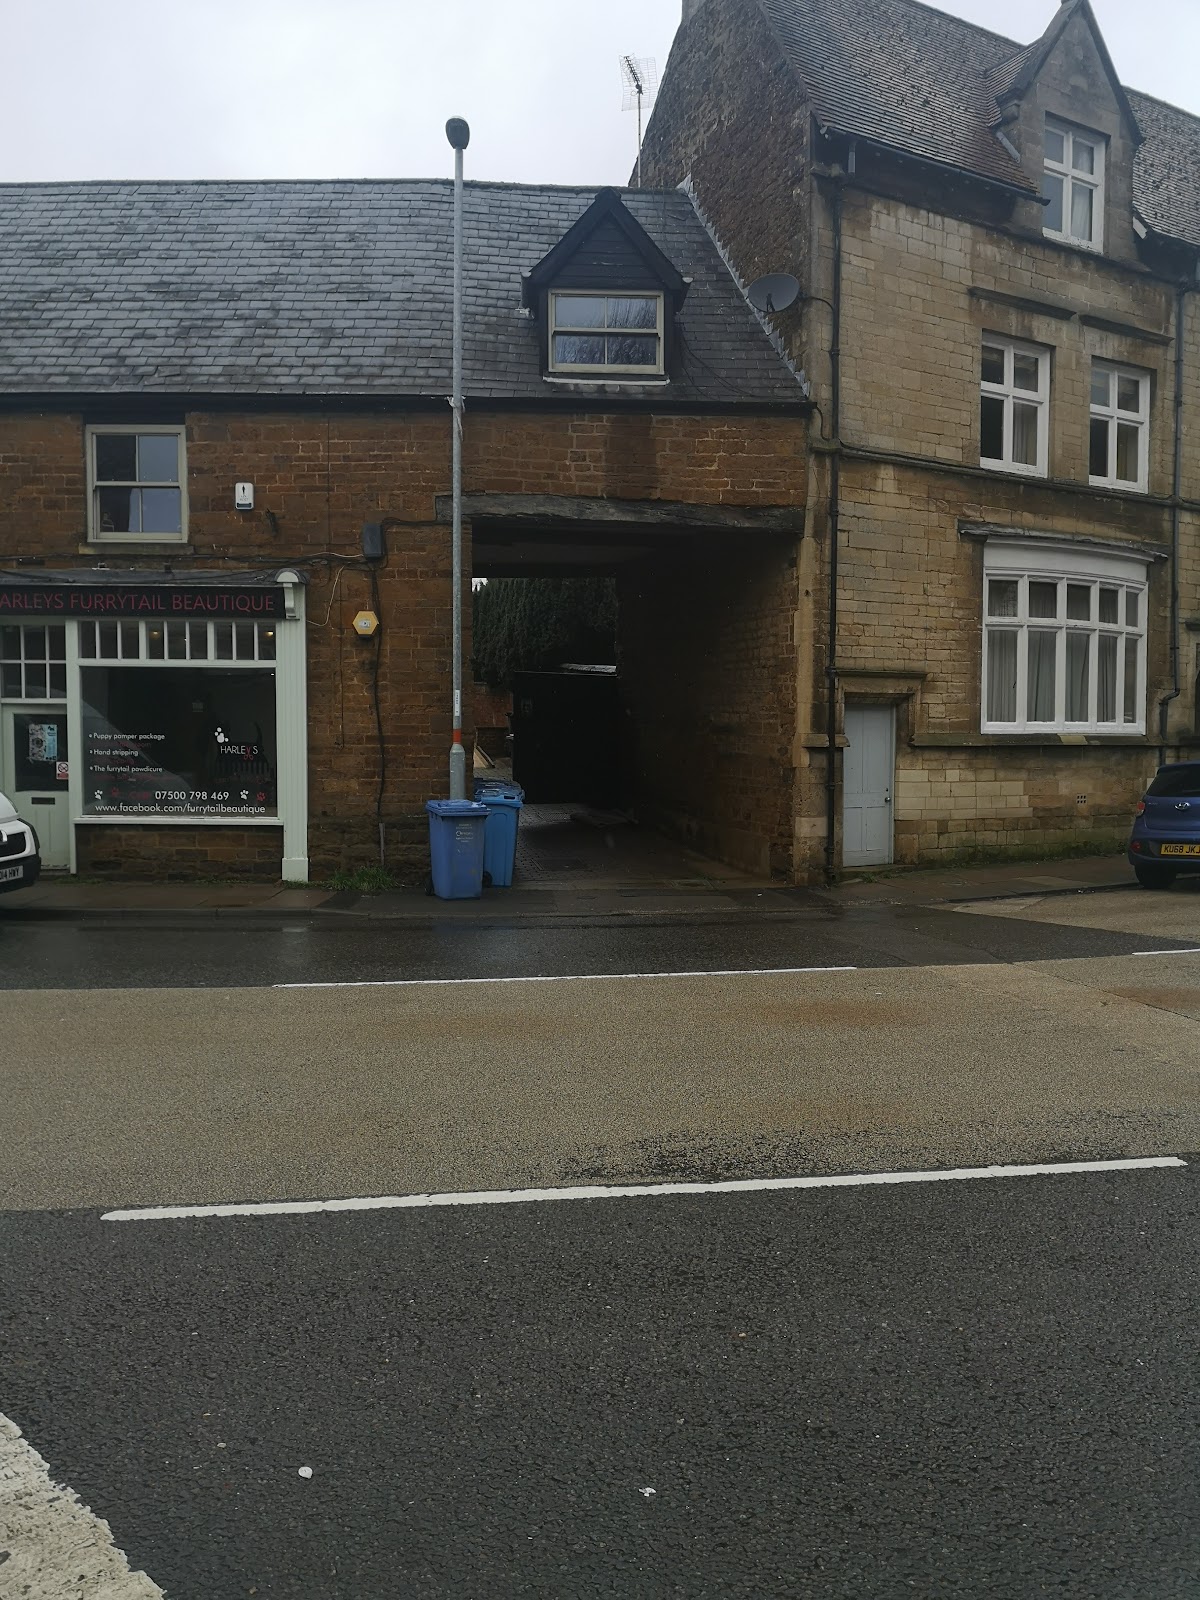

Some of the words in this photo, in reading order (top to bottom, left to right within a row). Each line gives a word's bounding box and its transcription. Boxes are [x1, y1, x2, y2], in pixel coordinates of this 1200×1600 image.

[70, 593, 166, 610] FURRYTAIL
[172, 595, 275, 612] BEAUTIQUE
[93, 732, 112, 740] Puppy
[113, 733, 137, 741] pamper
[138, 733, 165, 741] package
[112, 749, 139, 757] stripping
[106, 765, 130, 773] furrytail
[155, 790, 186, 800] 07500
[189, 791, 208, 801] 798
[210, 791, 230, 801] 469
[95, 802, 266, 814] www.facebook.com/furrytailbeautique
[1164, 845, 1184, 853] KU68
